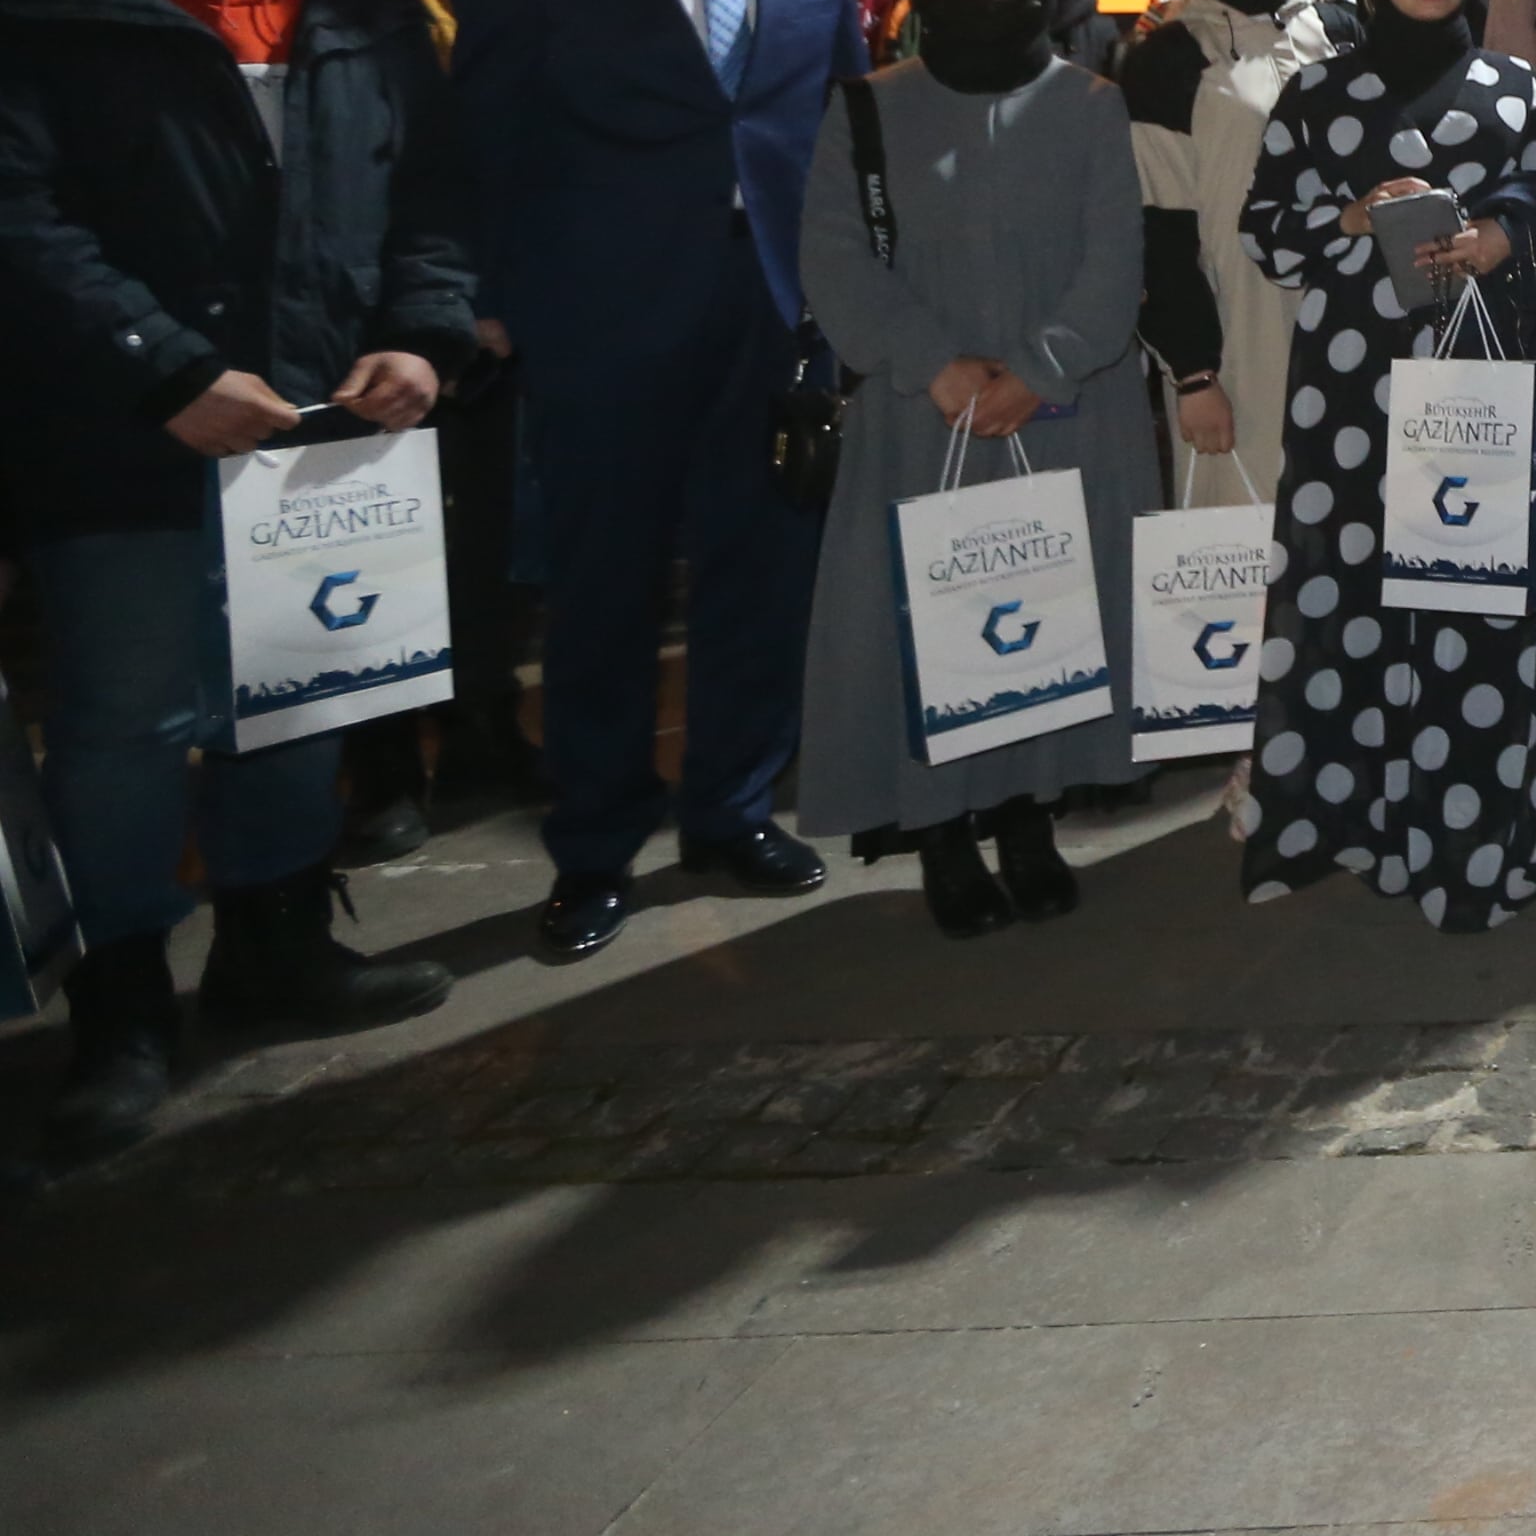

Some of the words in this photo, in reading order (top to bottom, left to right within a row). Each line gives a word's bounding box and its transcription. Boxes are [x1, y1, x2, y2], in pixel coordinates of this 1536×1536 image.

[1403, 417, 1518, 446] GAZİANTEP
[251, 498, 422, 547] GAZİANTEP
[928, 531, 1073, 582] GAZİANTEP
